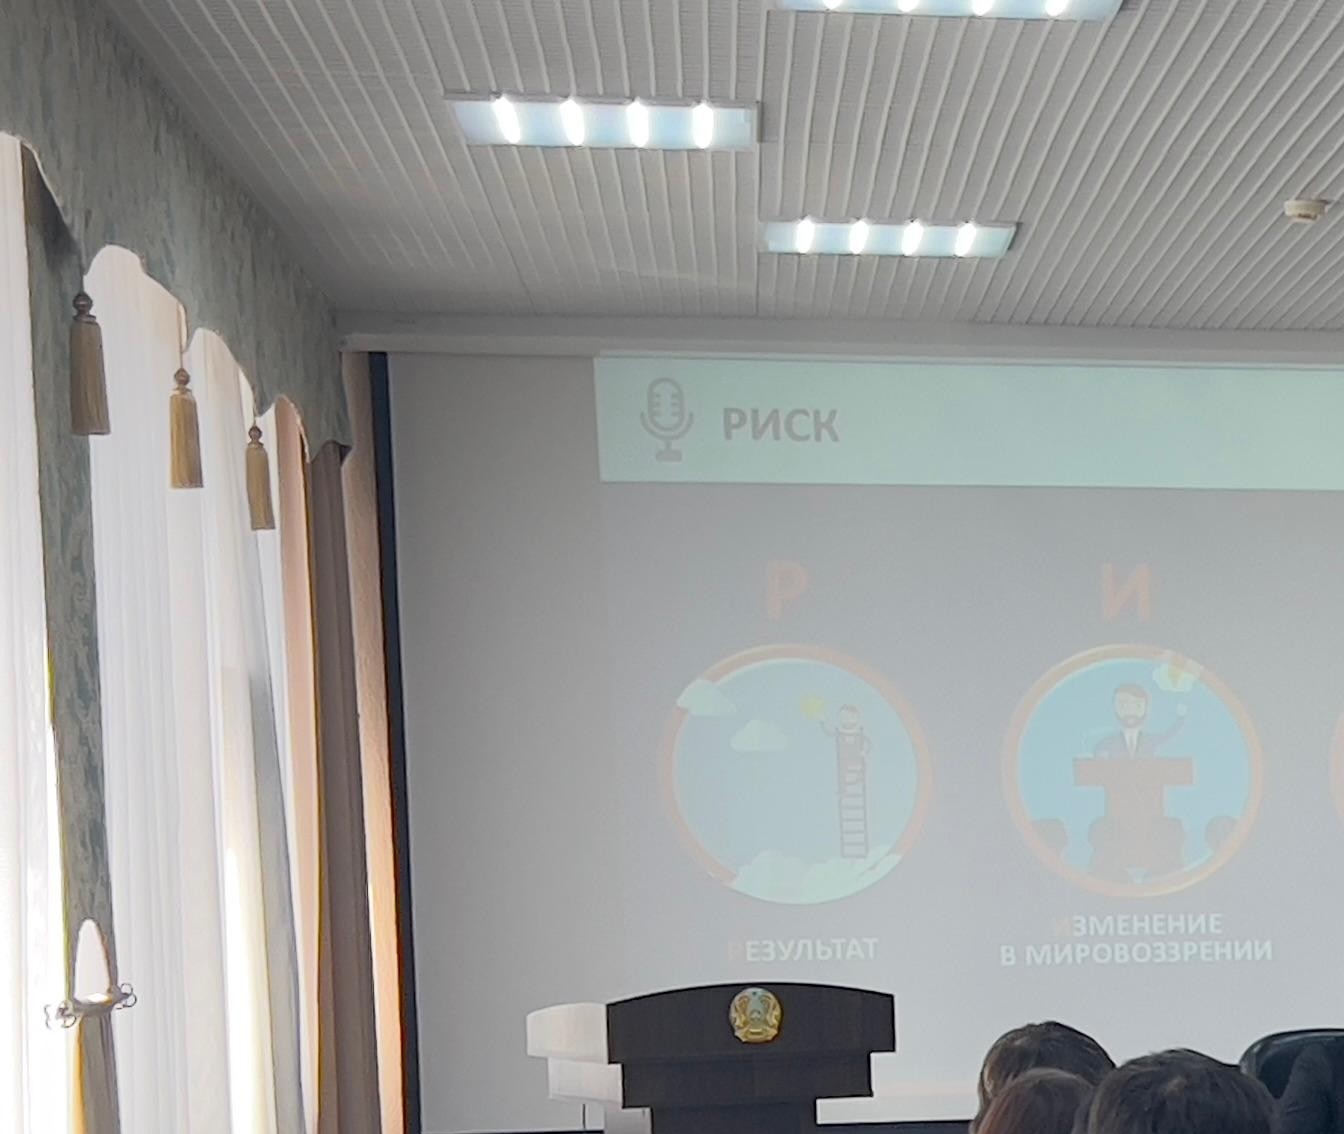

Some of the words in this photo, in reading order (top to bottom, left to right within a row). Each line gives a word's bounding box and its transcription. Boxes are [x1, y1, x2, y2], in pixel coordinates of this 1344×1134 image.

[724, 409, 839, 442] РИСК
[1101, 562, 1151, 622] И
[1000, 945, 1016, 966] В
[1025, 940, 1273, 966] МИРОВОЗЗРЕНИИ
